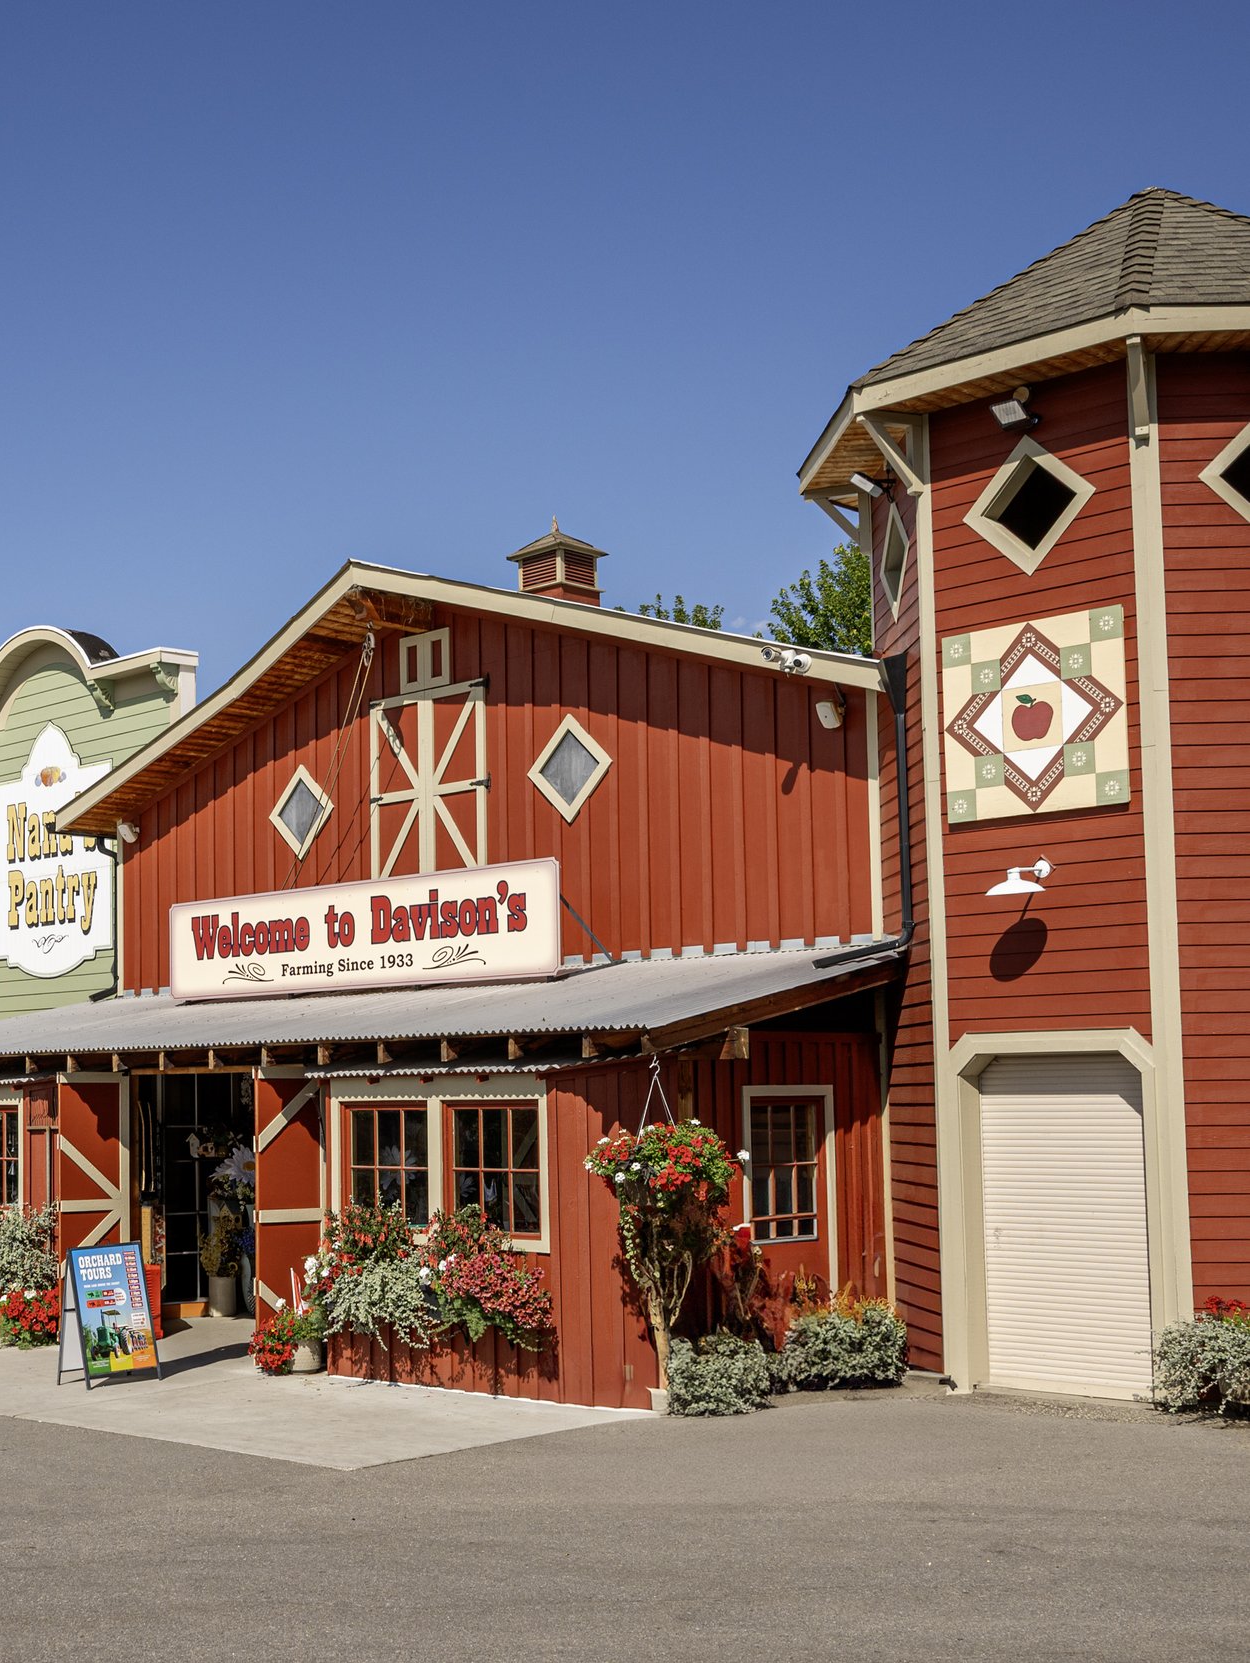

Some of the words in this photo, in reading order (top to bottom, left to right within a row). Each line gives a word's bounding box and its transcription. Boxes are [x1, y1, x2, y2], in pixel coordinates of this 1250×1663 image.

[7, 801, 97, 864] Nan
[8, 864, 98, 936] Pantry
[191, 911, 310, 961] Welcome
[325, 904, 356, 949] to
[370, 880, 528, 945] Davison's
[281, 960, 334, 978] Farming
[338, 958, 374, 974] Since
[379, 953, 414, 970] 1933
[78, 1253, 123, 1269] ORCHARD
[80, 1267, 112, 1281] TOURS
